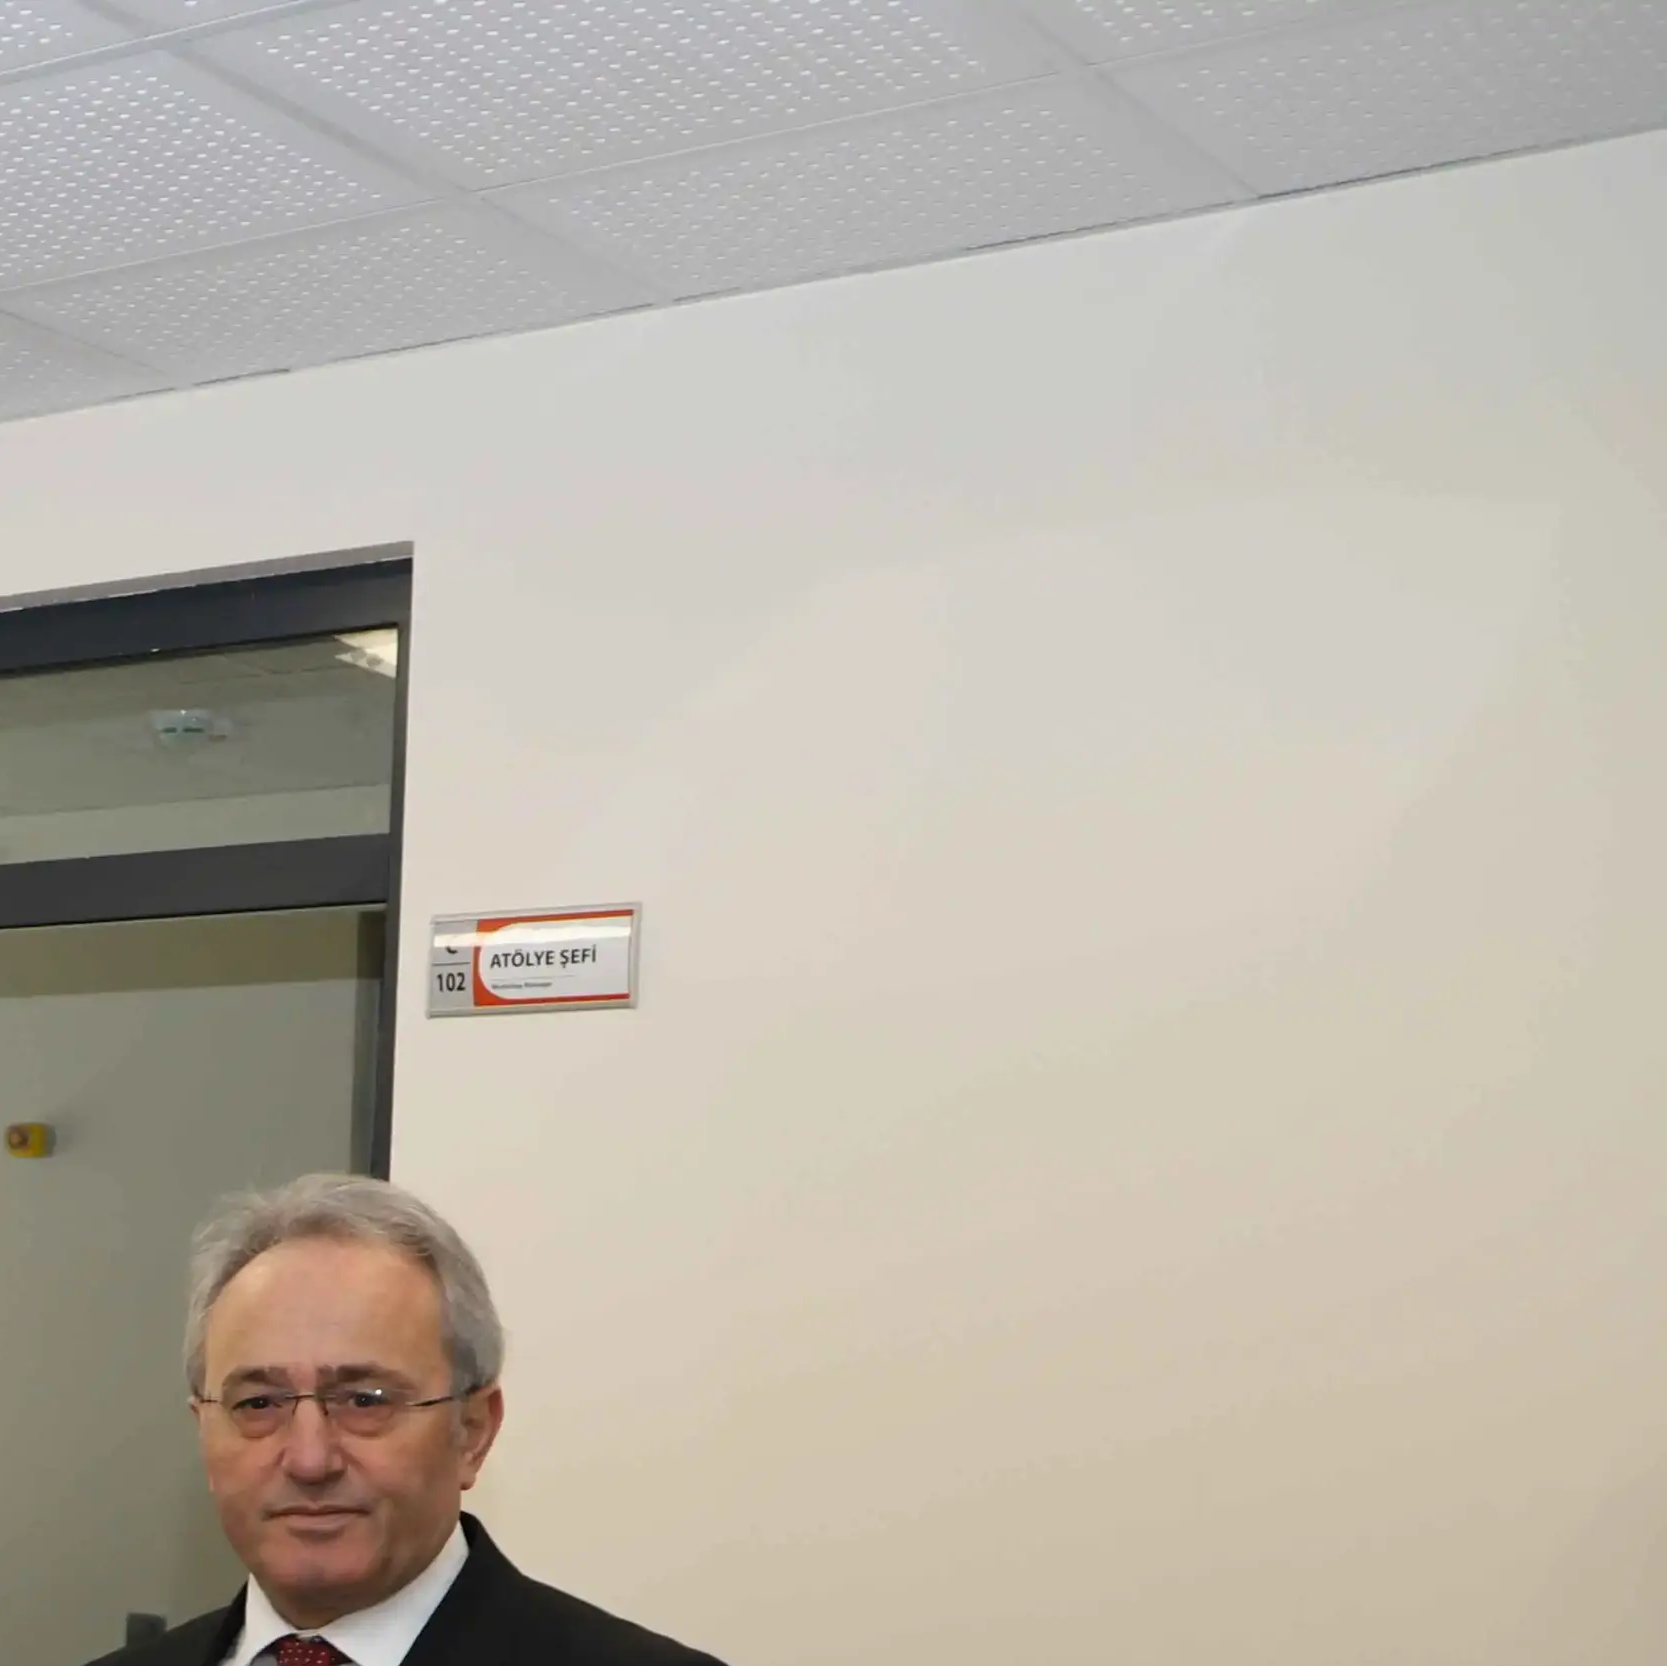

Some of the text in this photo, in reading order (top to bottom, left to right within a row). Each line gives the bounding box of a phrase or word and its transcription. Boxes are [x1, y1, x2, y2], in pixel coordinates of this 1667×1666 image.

[490, 944, 597, 969] ATÖLYE ŞEFİ
[437, 972, 466, 992] 102
